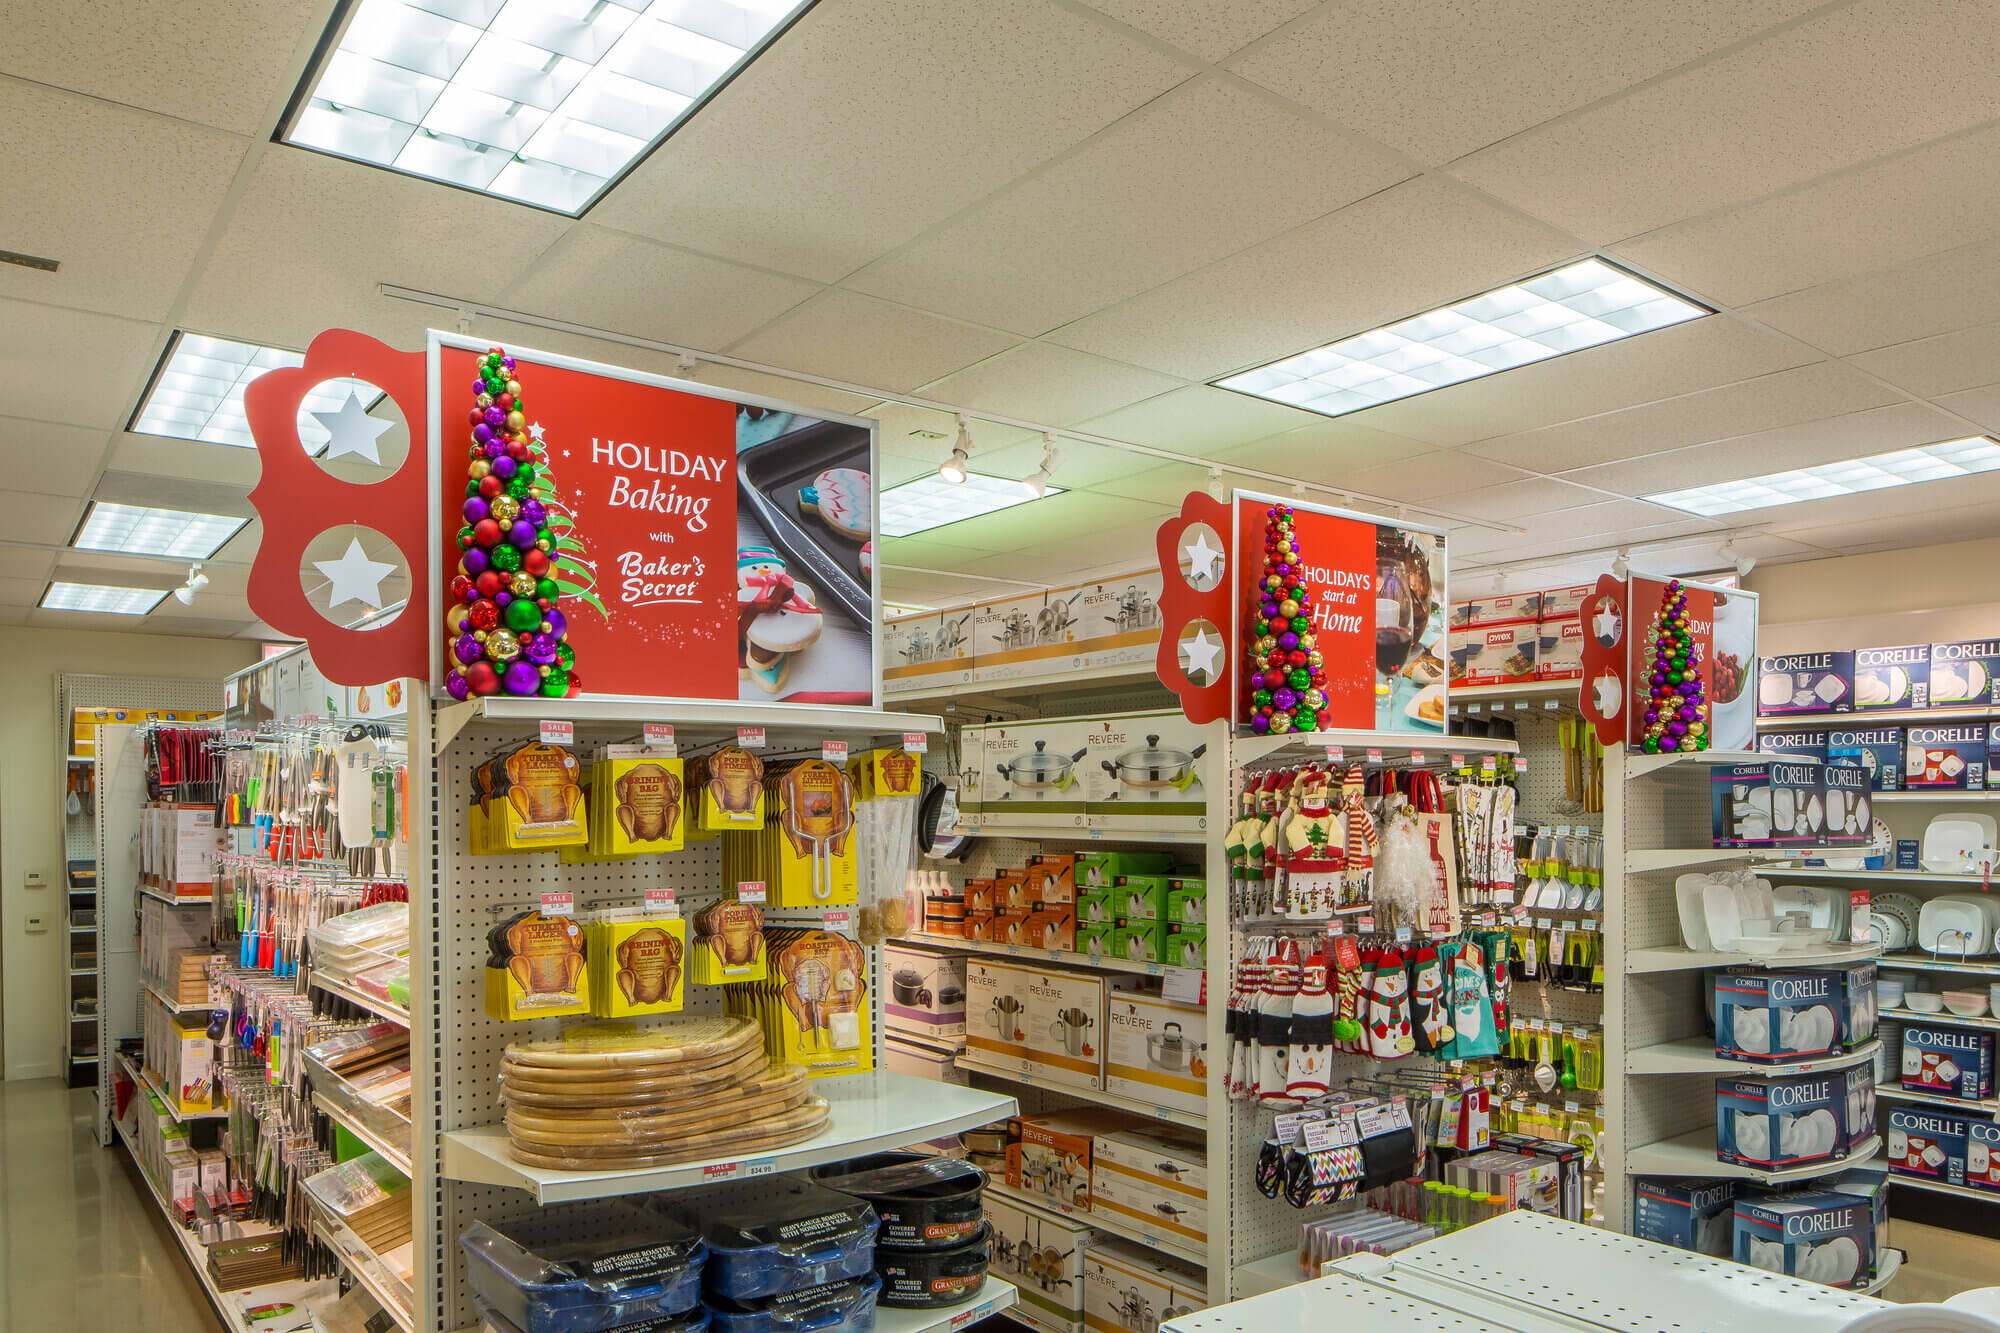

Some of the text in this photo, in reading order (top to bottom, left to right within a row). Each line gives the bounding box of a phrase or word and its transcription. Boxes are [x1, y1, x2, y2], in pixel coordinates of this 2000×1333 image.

[592, 438, 727, 482] HOLIDAY
[608, 476, 711, 532] Baking
[649, 532, 674, 543] with
[617, 551, 705, 577] Baker's
[1305, 566, 1371, 590] HOLIDAYS
[621, 578, 699, 602] Secret
[1322, 588, 1357, 605] start at
[1084, 593, 1115, 605] REVERE
[976, 614, 1001, 625] REVERE
[1313, 603, 1363, 634] Home
[1488, 632, 1512, 644] pyrex
[1564, 626, 1582, 636] pyre
[1857, 648, 1928, 665] CORELLE
[1933, 642, 2000, 660] CORELL
[1762, 654, 1832, 672] CORELLE
[1089, 734, 1128, 745] REVERE
[1761, 733, 1825, 748] CORELLE
[1830, 731, 1897, 745] CORELLE
[1908, 727, 1985, 743] CORELLE
[986, 740, 1019, 750] REVERE
[1733, 766, 1764, 775] CORELLE
[1772, 764, 1815, 784] CORELLE
[1825, 767, 1863, 786] CORELLE
[640, 785, 659, 793] BAG
[640, 948, 661, 956] BAG
[968, 975, 997, 988] REVERE
[1736, 978, 1763, 987] CORELLE
[1850, 967, 1872, 990] CORELLE
[1029, 984, 1063, 999] REVERE
[1771, 978, 1829, 1000] CORELLE
[1112, 1013, 1153, 1029] REVERE
[1905, 1028, 1980, 1050] CORELLE
[1847, 1063, 1869, 1089] CORELLE
[1735, 1083, 1763, 1094] CORELLE
[1771, 1082, 1830, 1107] CORELLE
[1891, 1112, 1965, 1136] CORELLE
[1023, 1128, 1053, 1144] REVERE
[1639, 1182, 1666, 1194] CORELLE
[1693, 1182, 1735, 1210] CORELLE
[1752, 1208, 1780, 1222] CORELLE
[1787, 1210, 1853, 1236] CORELLE
[593, 1265, 614, 1275] WITH
[615, 1257, 650, 1270] NONSTICK
[1085, 1270, 1117, 1289] REVERE
